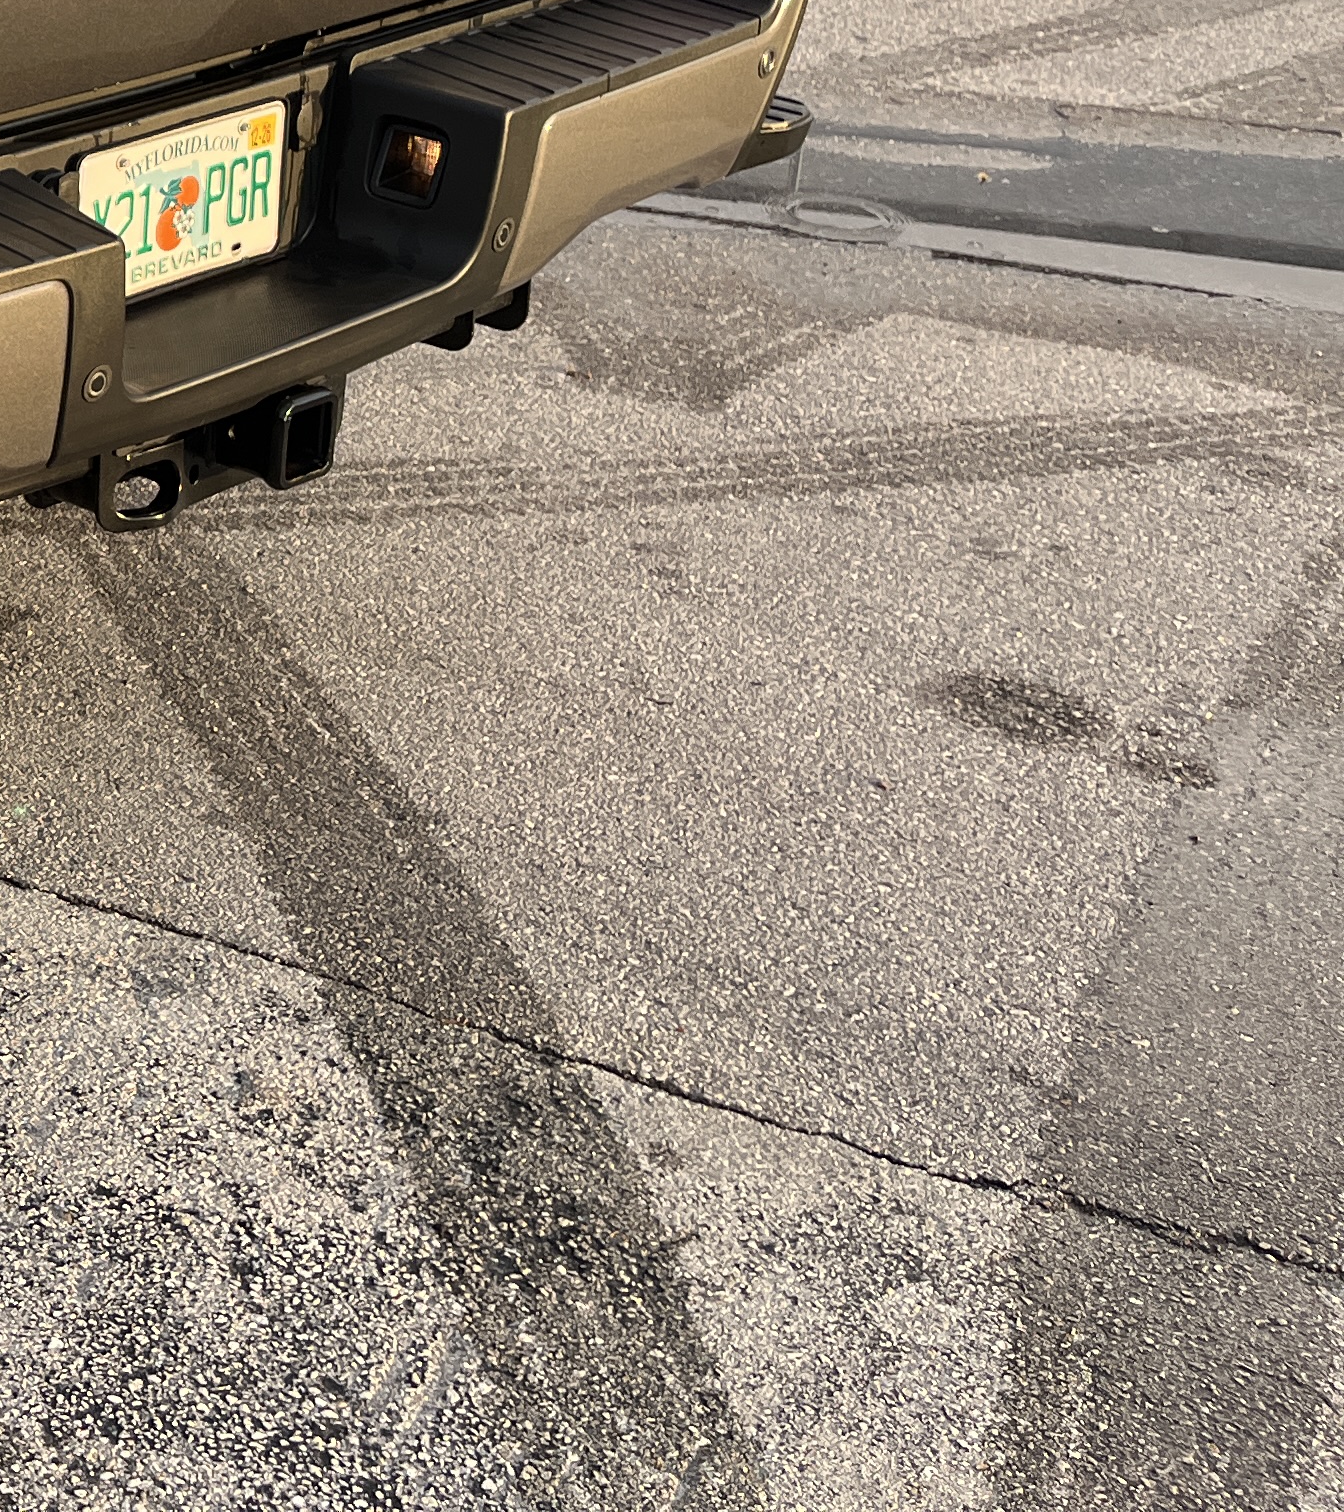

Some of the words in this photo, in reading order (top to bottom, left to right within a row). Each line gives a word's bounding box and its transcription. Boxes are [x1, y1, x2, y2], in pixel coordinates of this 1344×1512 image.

[123, 133, 240, 185] MYFLORIDA.COM
[201, 149, 273, 236] PGR
[130, 241, 223, 284] BREVARD
